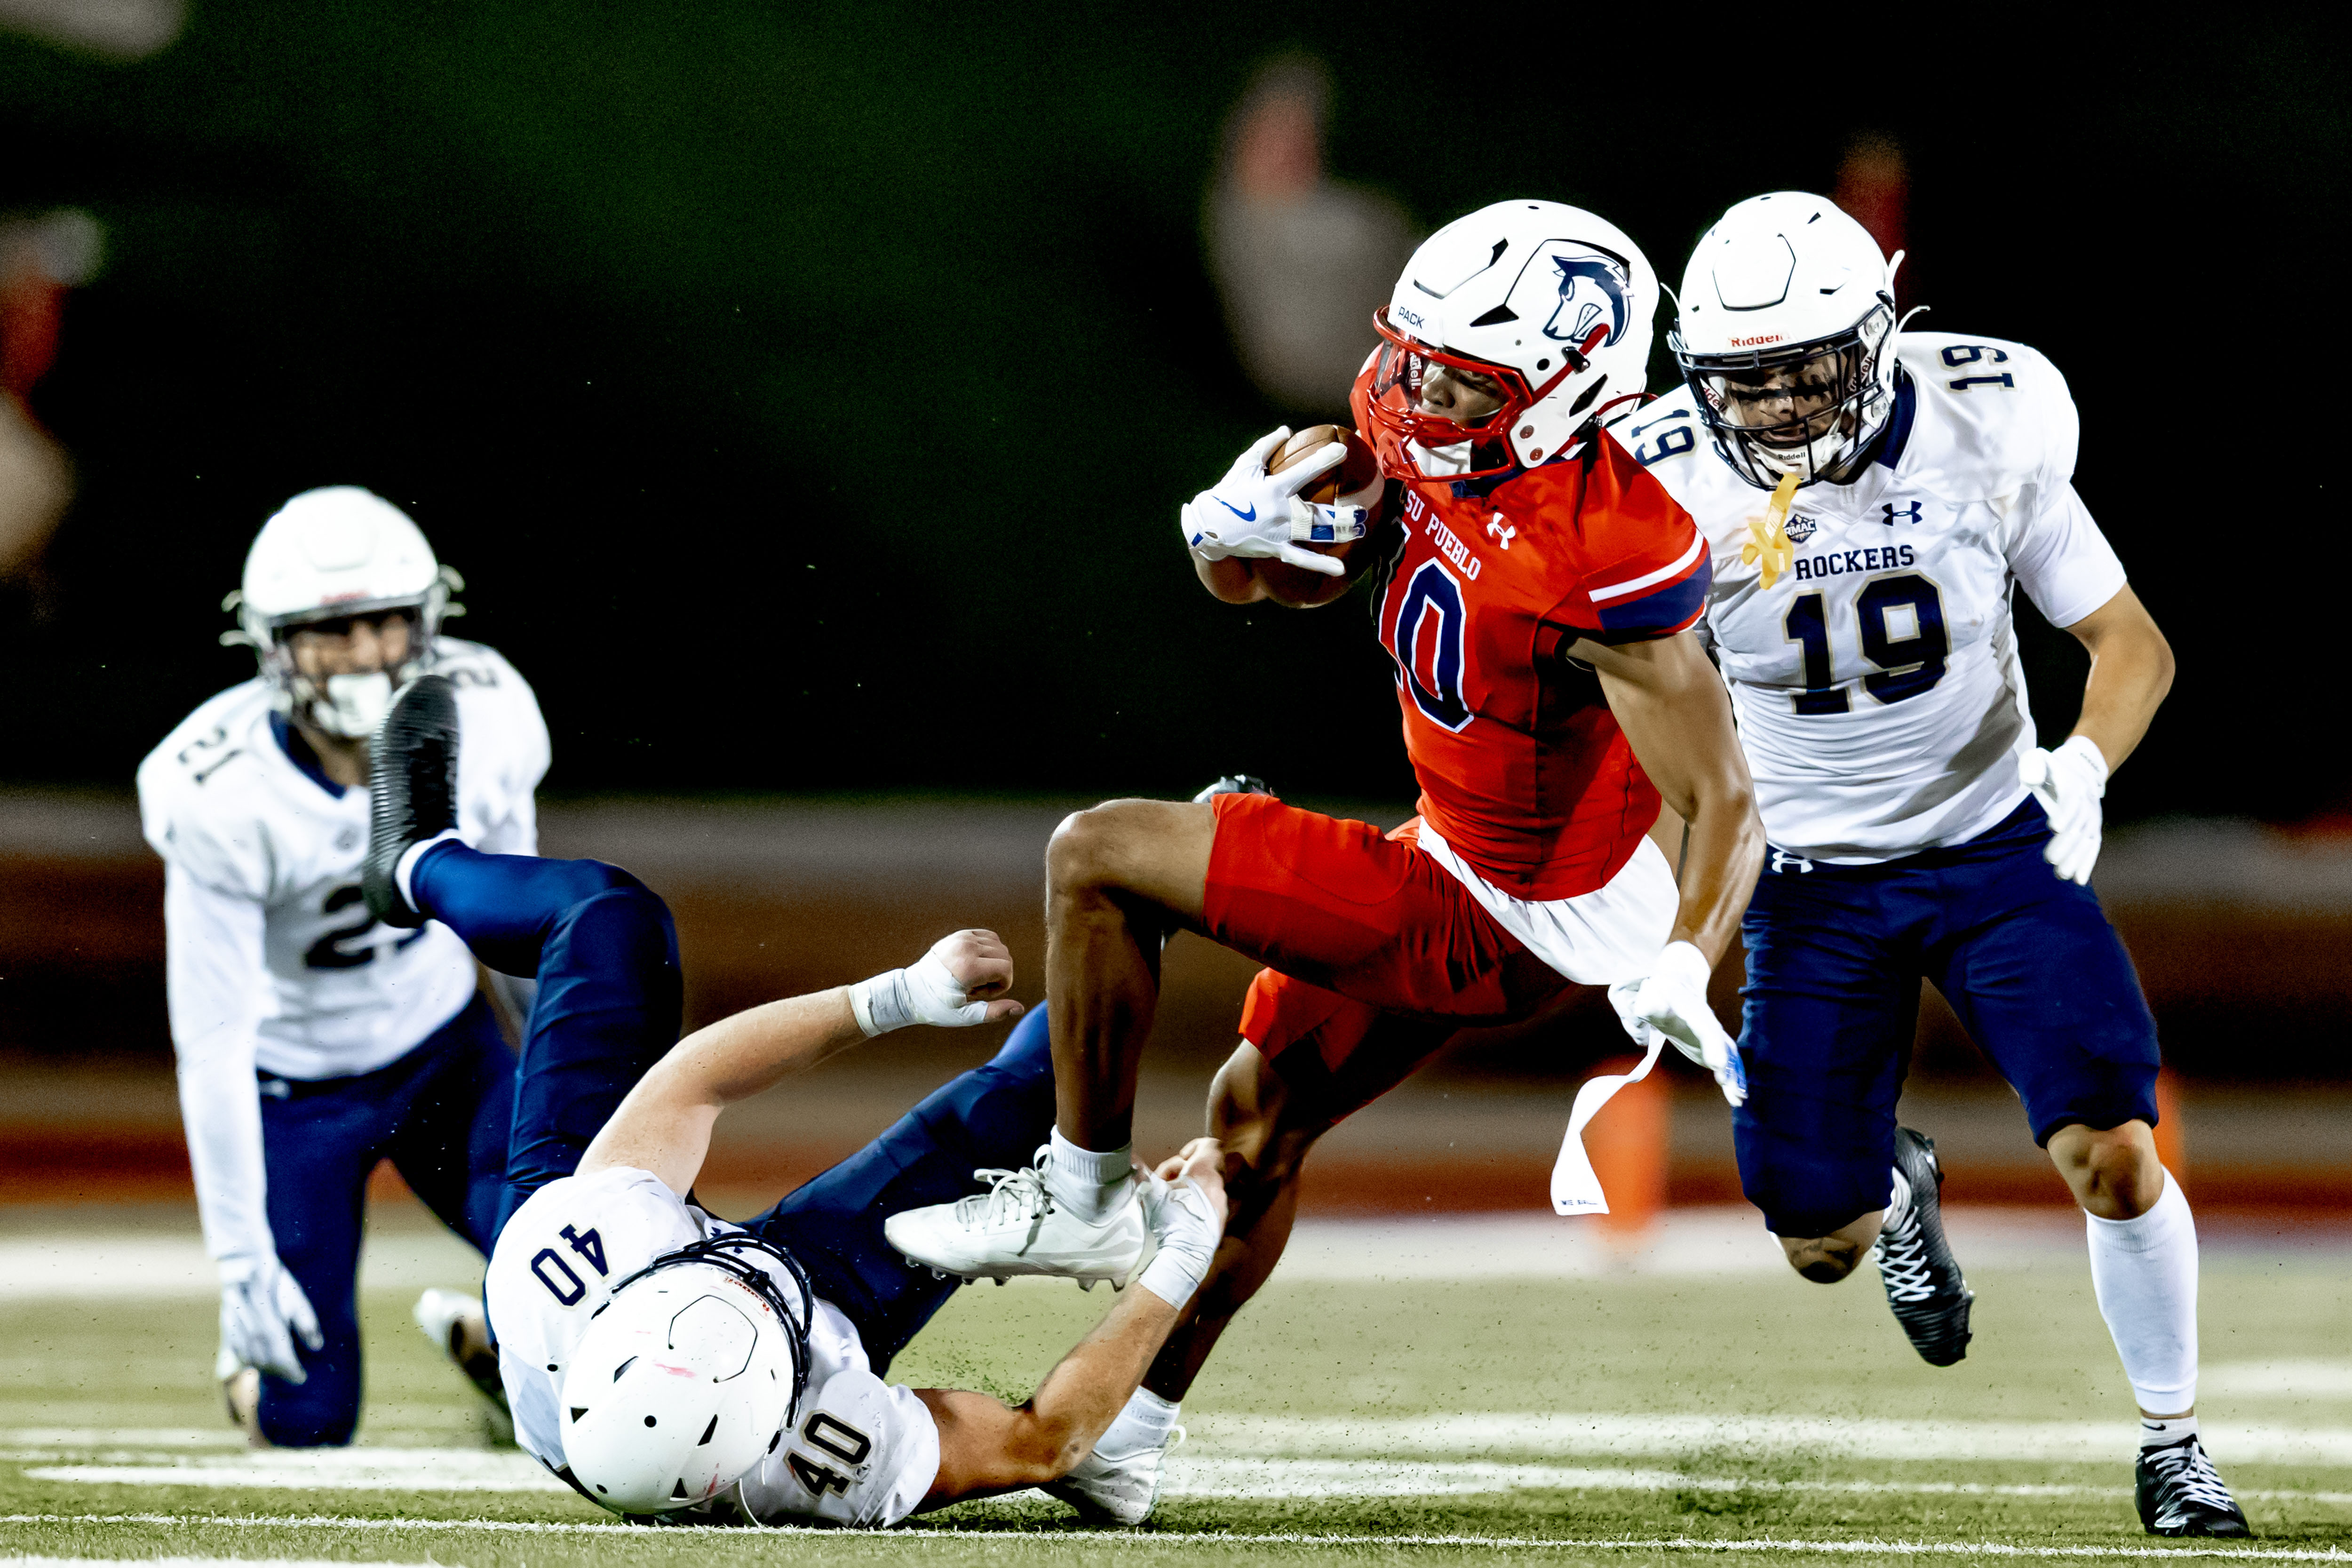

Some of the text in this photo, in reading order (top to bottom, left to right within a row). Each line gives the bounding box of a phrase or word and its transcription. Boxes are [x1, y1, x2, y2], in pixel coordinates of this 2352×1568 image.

[1398, 306, 1425, 330] PACK
[1936, 345, 2018, 394] 19
[1631, 408, 1697, 468] 19
[1403, 487, 1481, 581] SU PUEBLO
[1783, 520, 1815, 536] RMAC
[1794, 545, 1915, 581] ROCKERS
[1782, 569, 1952, 715] 19
[527, 1220, 612, 1310] 40
[783, 1409, 874, 1501] 40
